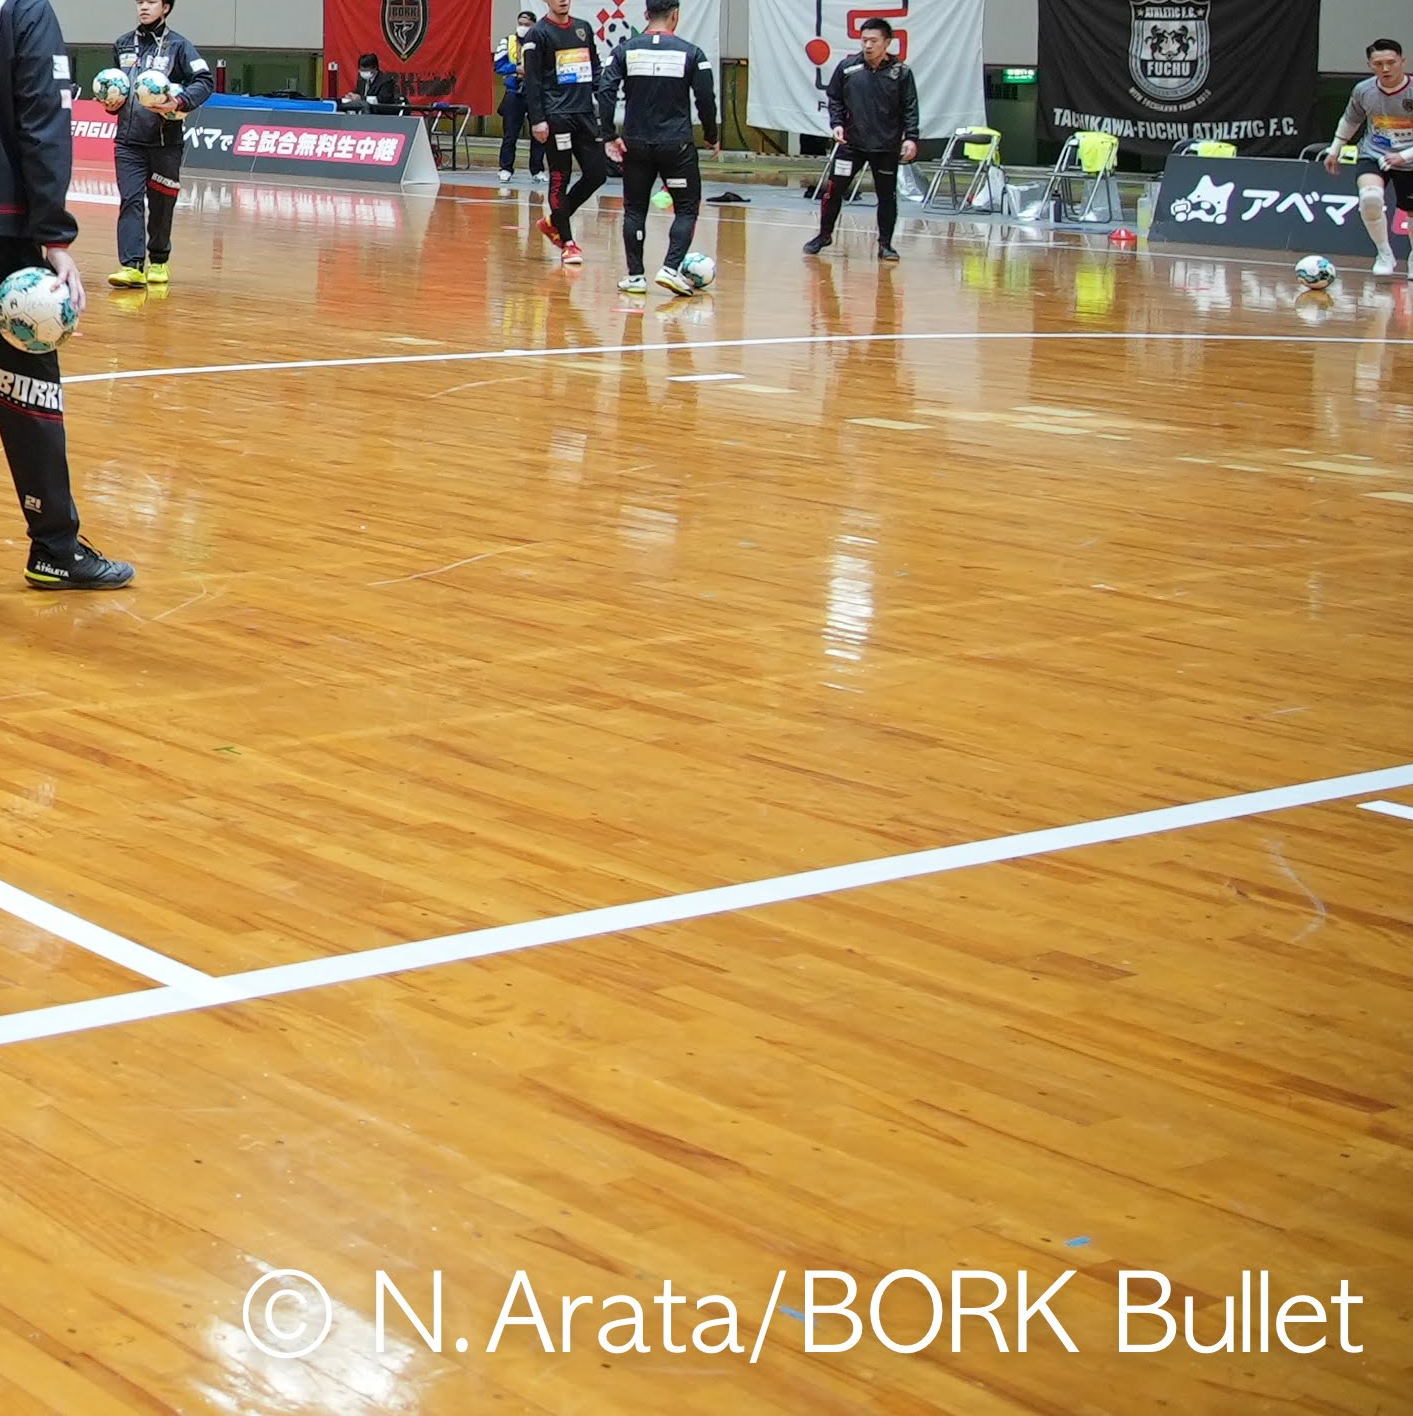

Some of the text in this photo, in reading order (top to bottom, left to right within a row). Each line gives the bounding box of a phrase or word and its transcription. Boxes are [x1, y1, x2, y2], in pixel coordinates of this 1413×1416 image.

[1144, 6, 1198, 19] ATHLETIC F.C.
[1147, 61, 1191, 77] FUCHU
[1192, 119, 1265, 141] ATHLETIC
[1269, 117, 1299, 137] F.C.
[237, 128, 400, 163] 全試合無料生中継
